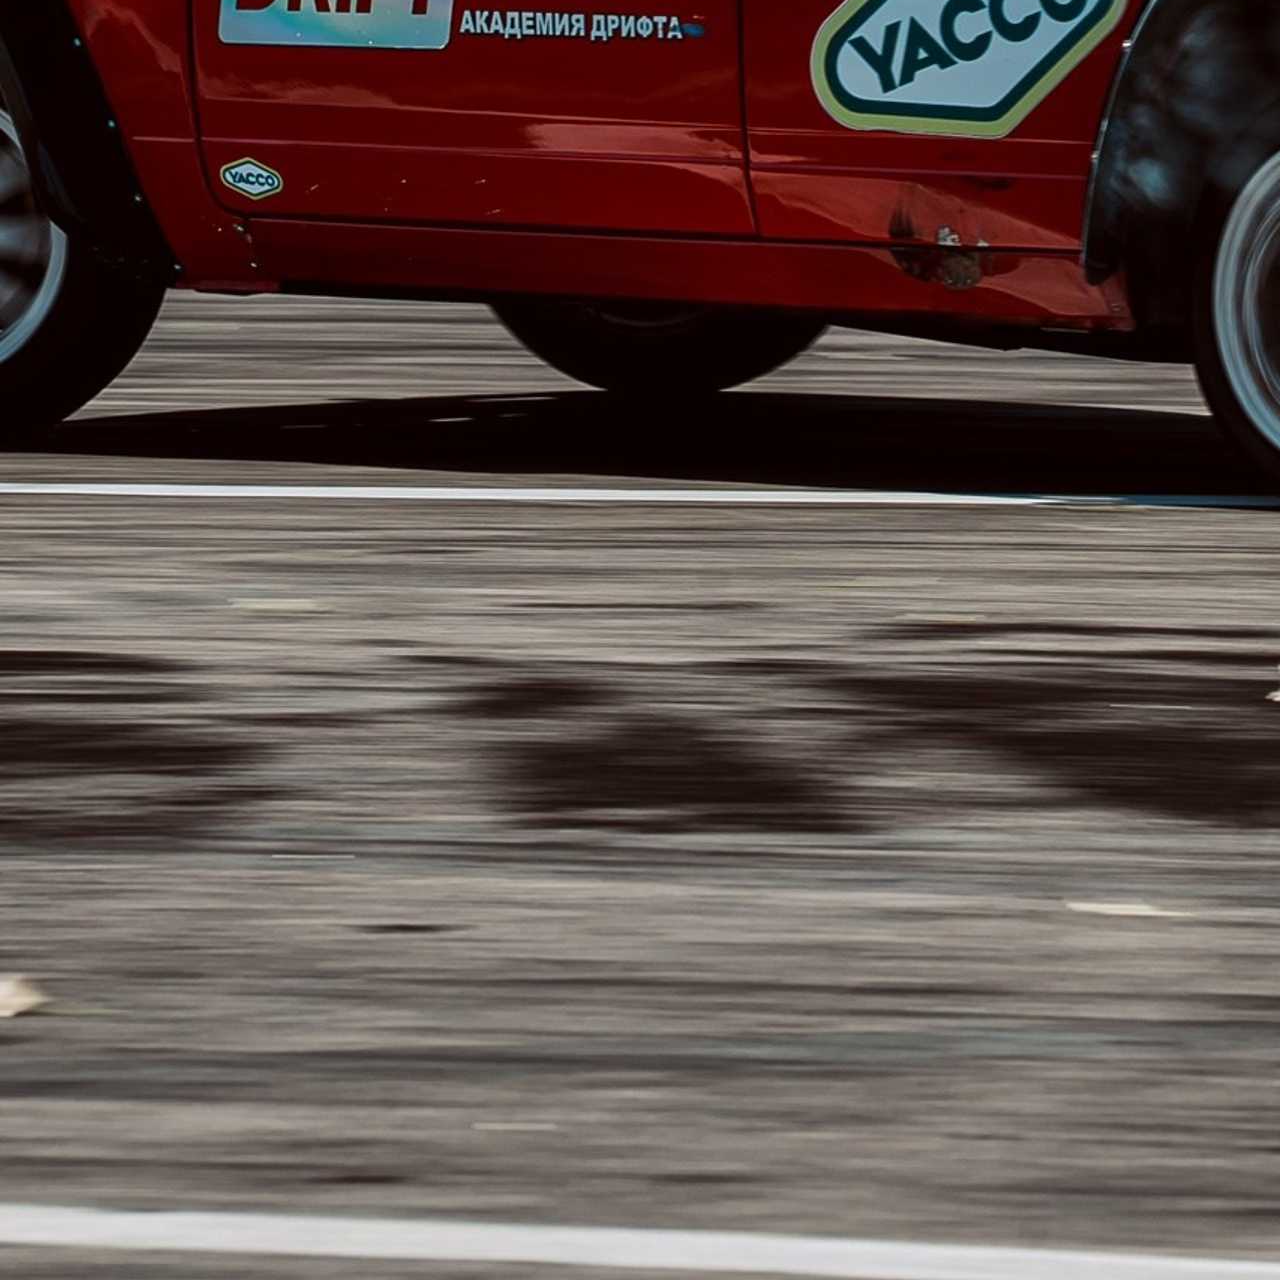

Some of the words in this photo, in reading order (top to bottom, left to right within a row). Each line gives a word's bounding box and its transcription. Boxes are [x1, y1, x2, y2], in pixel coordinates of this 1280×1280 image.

[459, 9, 586, 39] АКАДЕМИЯ
[590, 15, 684, 41] ДРИФТА
[228, 170, 276, 187] YACCO
